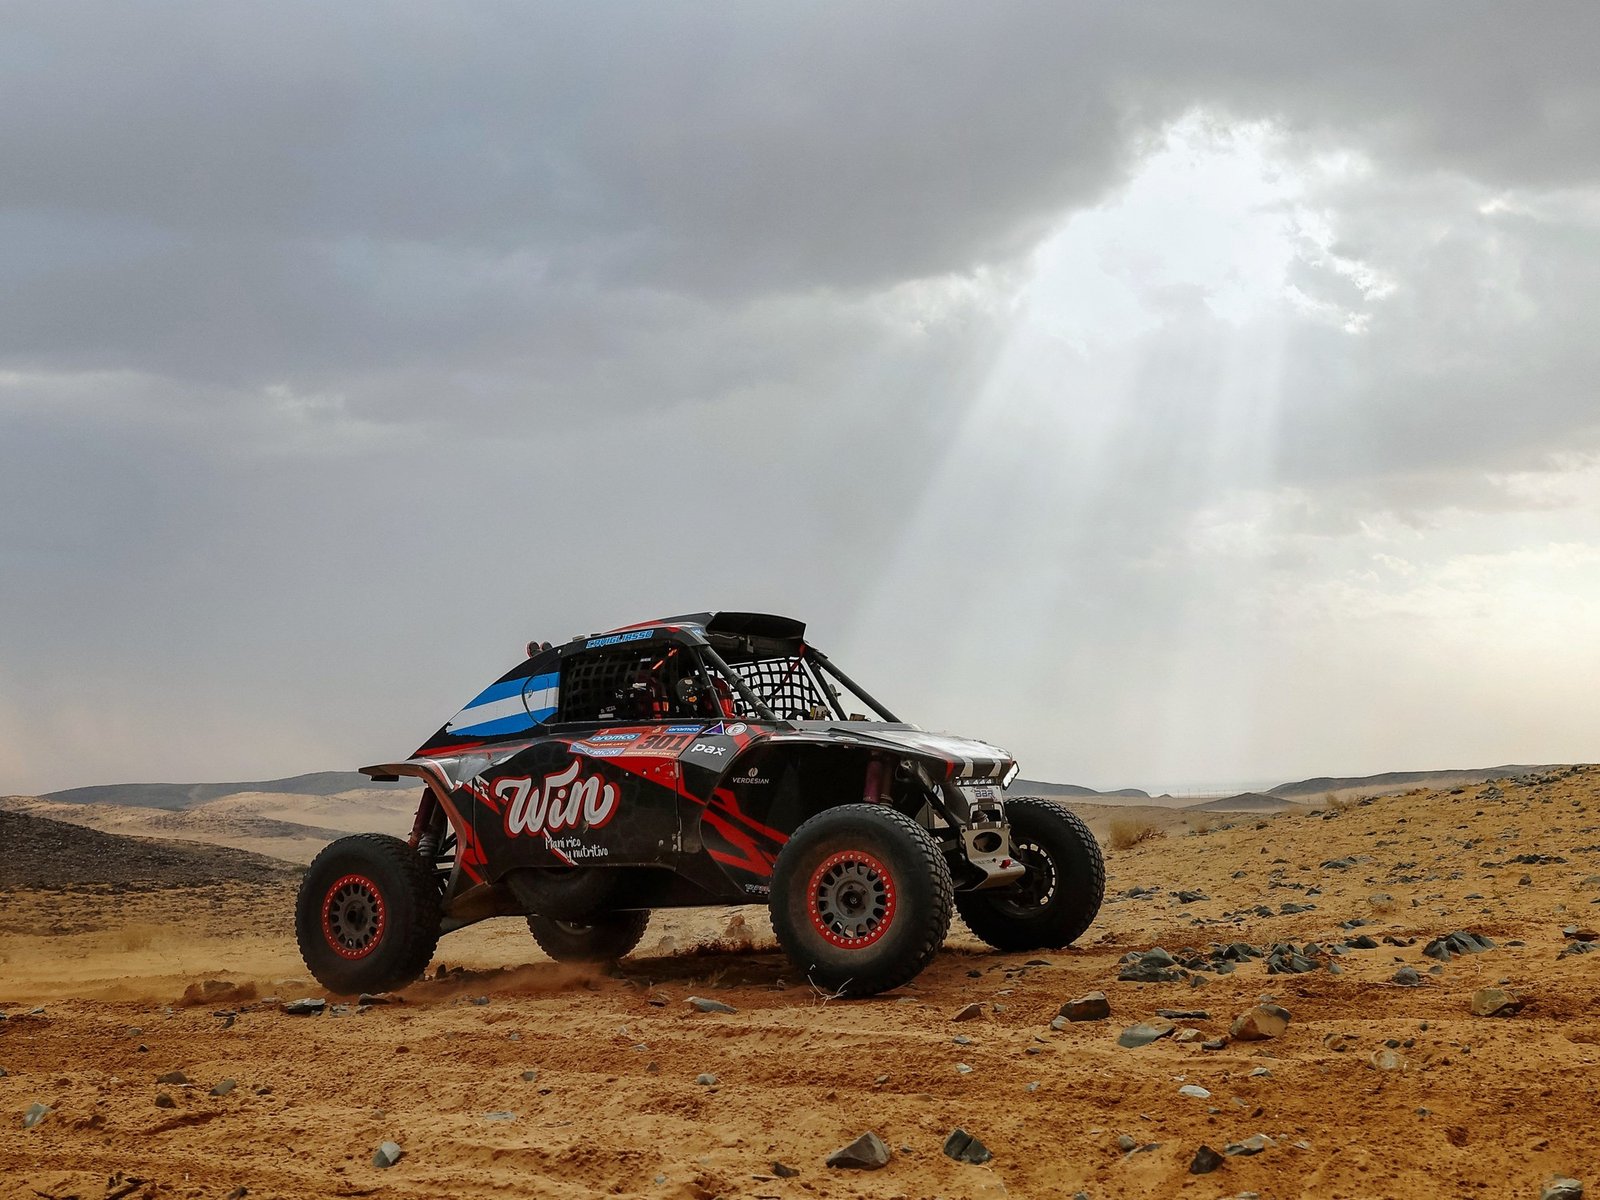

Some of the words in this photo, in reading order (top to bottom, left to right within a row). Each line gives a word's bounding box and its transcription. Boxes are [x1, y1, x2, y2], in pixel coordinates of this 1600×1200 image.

[636, 735, 688, 750] 301
[691, 743, 726, 756] pax
[495, 760, 615, 834] Win
[545, 837, 565, 849] Maní
[566, 836, 581, 848] rico
[566, 850, 572, 863] y
[572, 844, 608, 858] nutritivo
